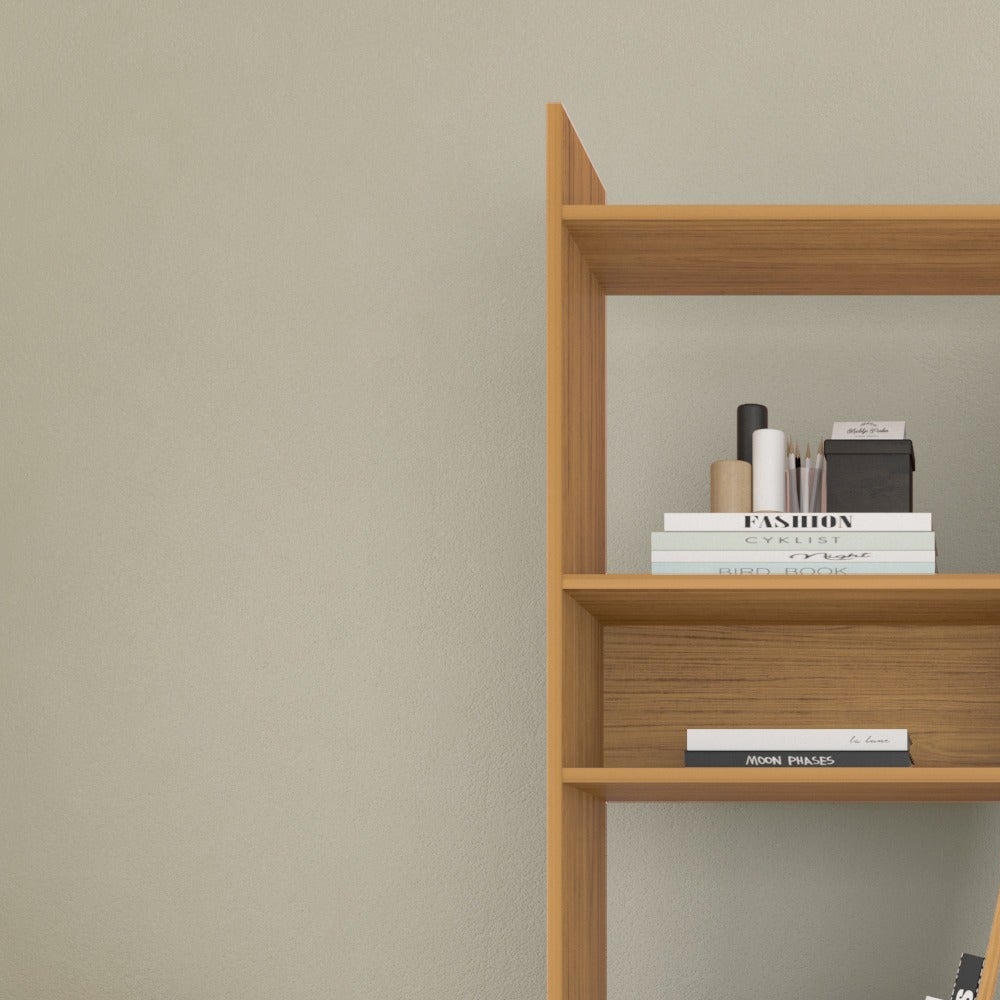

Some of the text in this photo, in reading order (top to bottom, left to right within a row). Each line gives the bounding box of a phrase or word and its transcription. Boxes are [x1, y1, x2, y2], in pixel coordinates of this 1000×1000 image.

[744, 515, 853, 529] FASHION
[745, 536, 842, 545] CYKLIST
[746, 755, 835, 767] MOON PHASES
